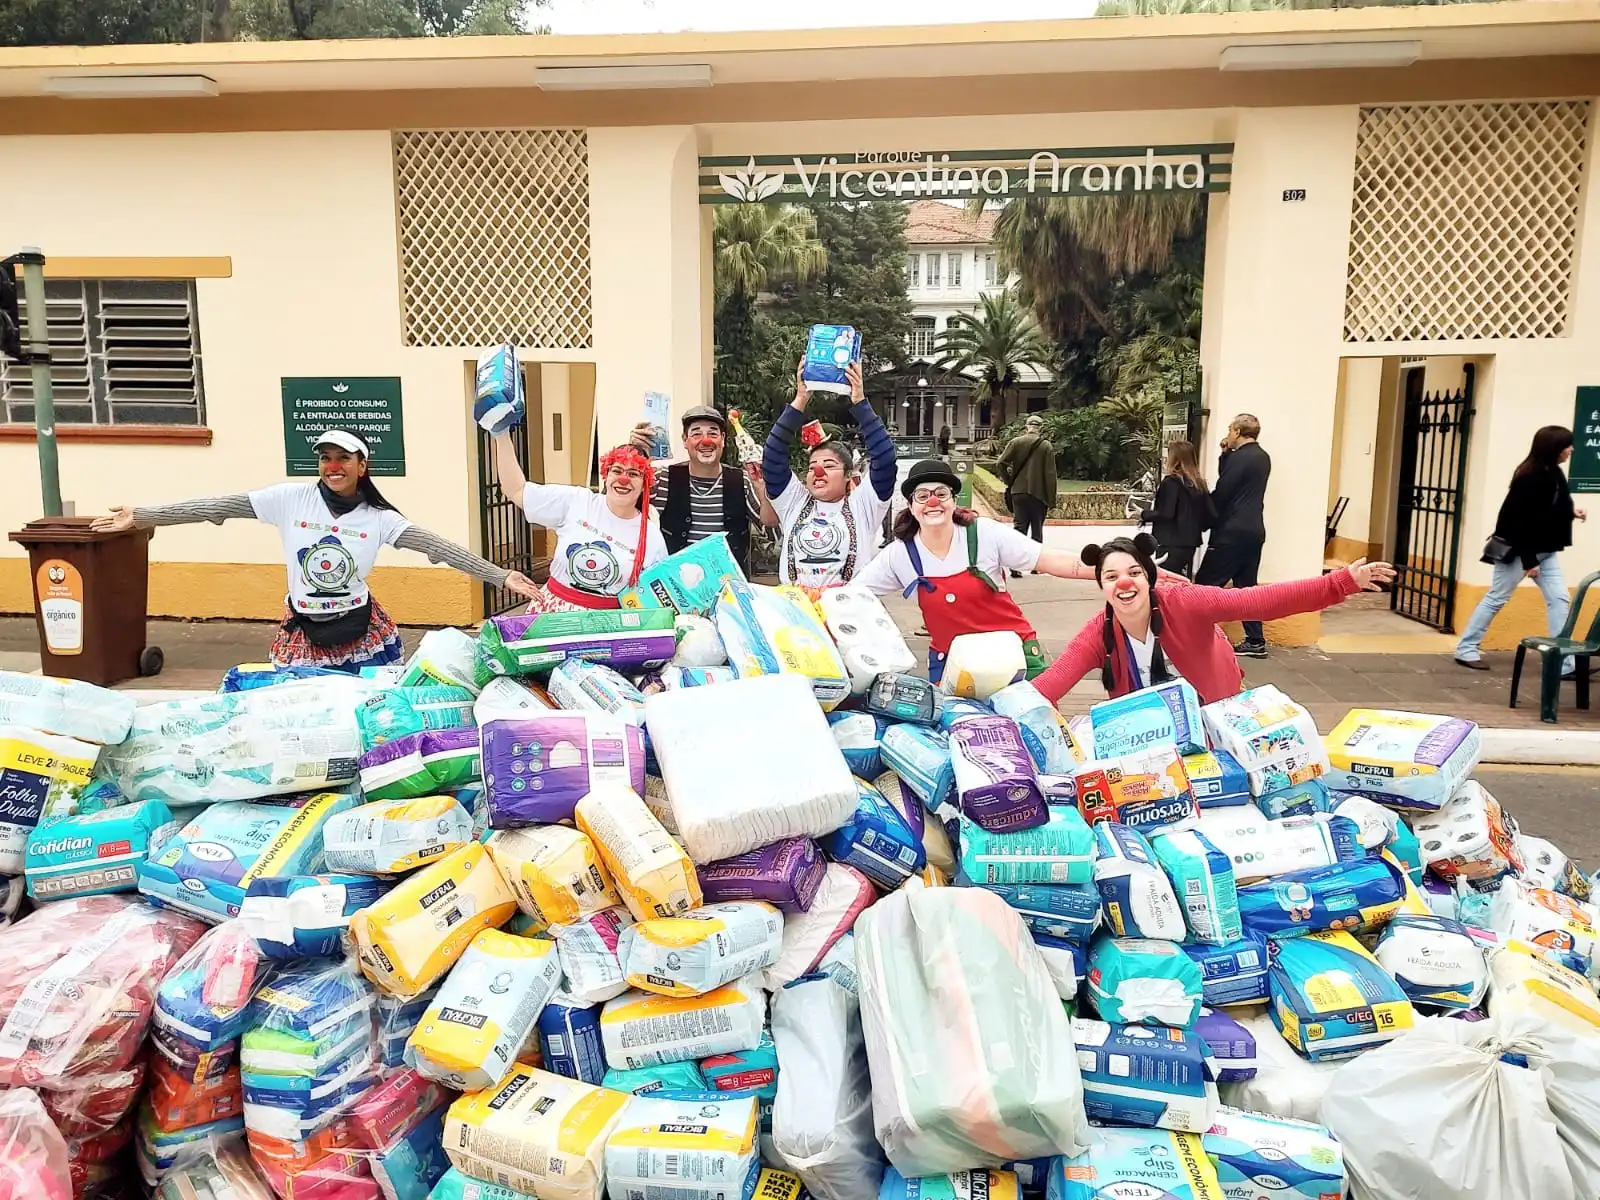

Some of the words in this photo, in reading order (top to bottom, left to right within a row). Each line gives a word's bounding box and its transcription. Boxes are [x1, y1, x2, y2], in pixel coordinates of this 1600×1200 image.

[793, 154, 1008, 198] Vicentina
[1028, 147, 1206, 193] Aranha
[1284, 190, 1305, 201] 302
[295, 398, 301, 407] É
[302, 399, 339, 407] PROIBIDO
[340, 399, 346, 407] O
[347, 399, 387, 407] CONSUMO
[307, 412, 344, 420] ENTRADA
[359, 424, 391, 432] PARQUE
[46, 610, 76, 622] orgânico
[1130, 725, 1172, 747] maxi
[17, 753, 45, 766] LEVE
[60, 762, 86, 776] PAGUE
[1354, 764, 1392, 776] BIGFRAL
[0, 785, 38, 803] Folha
[1084, 791, 1106, 809] 15
[0, 800, 38, 819] Dupla
[1125, 801, 1191, 827] Personal
[981, 805, 1038, 831] Adultcare
[29, 837, 93, 856] Cotidian
[423, 881, 455, 908] BIGFRAL
[374, 945, 393, 973] BIGFRAL
[442, 1009, 485, 1029] BIGFRAL
[1346, 1010, 1374, 1023] G/EG
[1379, 1013, 1394, 1025] 16
[493, 1076, 529, 1107] BIGFRAL
[378, 1102, 406, 1125] Intimus
[664, 1124, 704, 1134] BIGFRAL
[1144, 1159, 1175, 1171] Slip
[766, 1178, 793, 1192] MAS
[769, 1171, 797, 1186] LLEVE
[1258, 1177, 1282, 1187] TENA
[763, 1184, 790, 1200] POR
[1114, 1188, 1151, 1197] TENA
[1222, 1187, 1255, 1198] onfort
